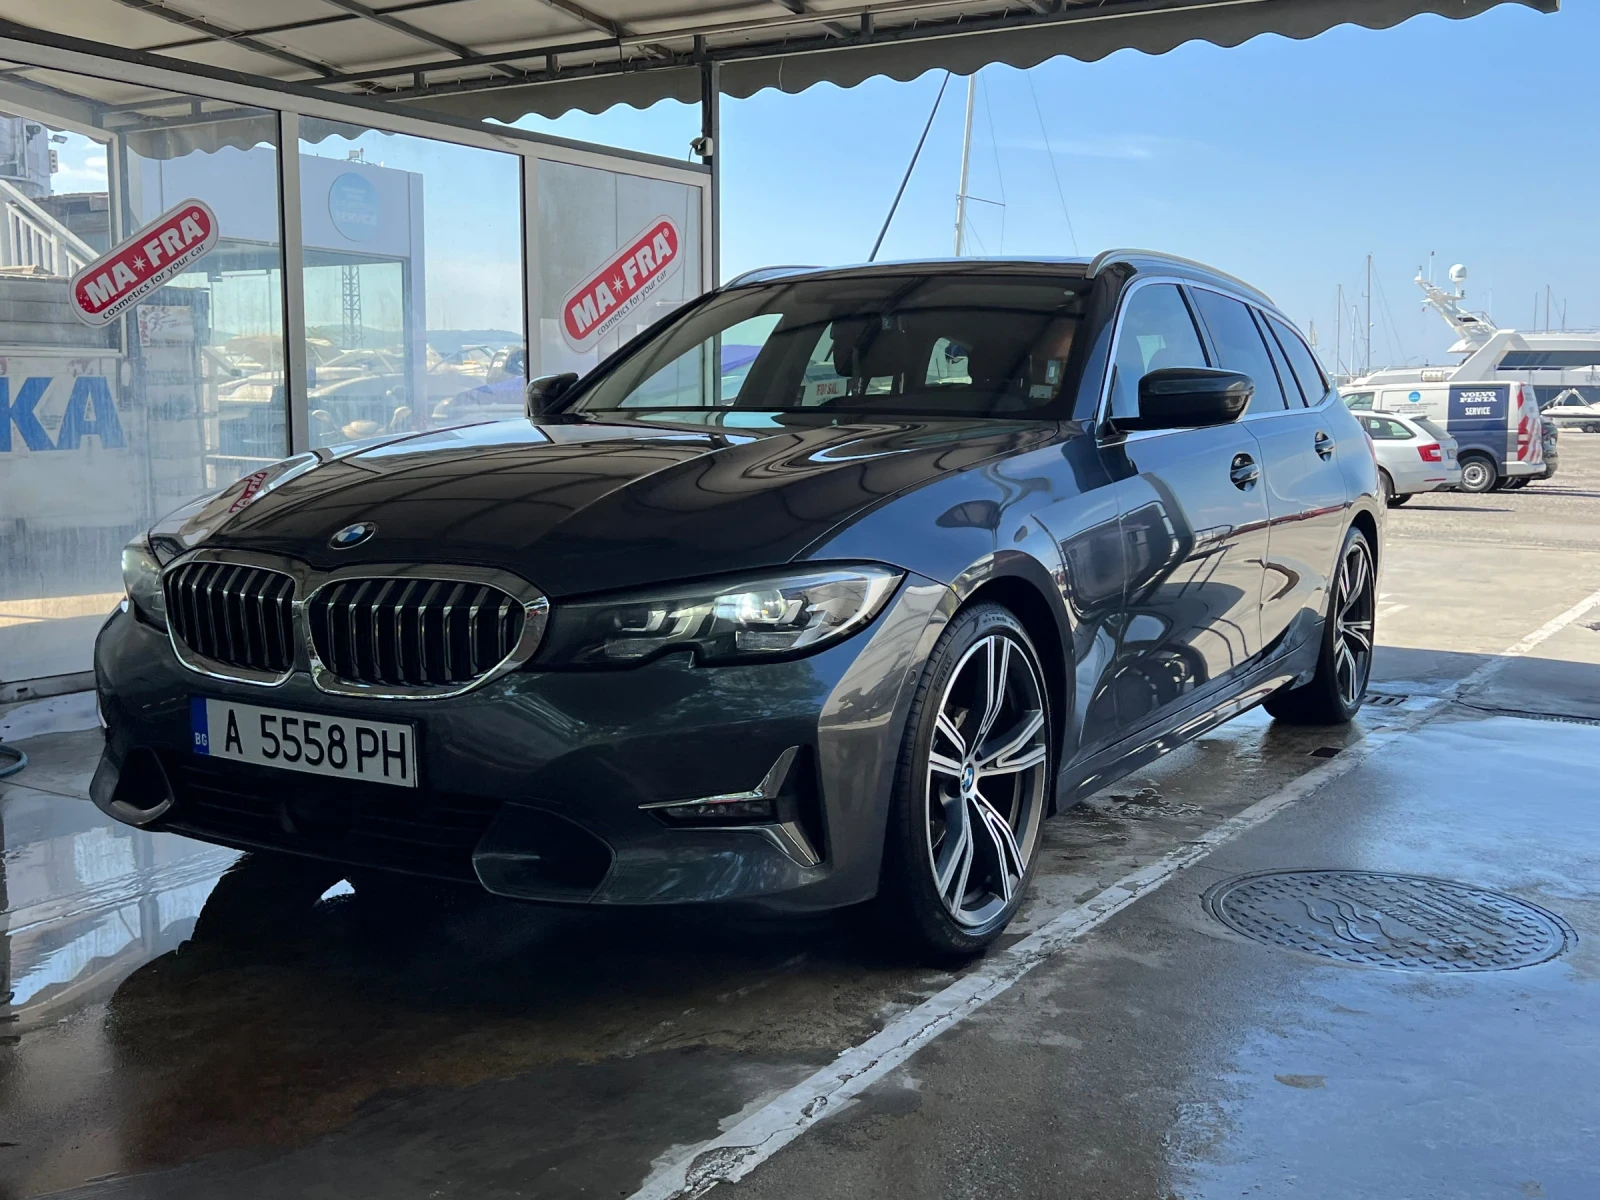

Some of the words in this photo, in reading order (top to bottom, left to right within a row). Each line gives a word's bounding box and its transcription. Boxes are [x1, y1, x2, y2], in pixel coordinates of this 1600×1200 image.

[103, 285, 149, 319] cosmetics
[151, 271, 165, 285] for
[167, 255, 189, 275] your
[191, 243, 205, 257] car
[597, 305, 629, 336] cosmetics
[630, 295, 640, 307] for
[641, 281, 656, 299] your
[656, 270, 667, 282] car
[1465, 407, 1491, 416] SERVICE
[194, 732, 208, 747] BG
[225, 708, 243, 755] A
